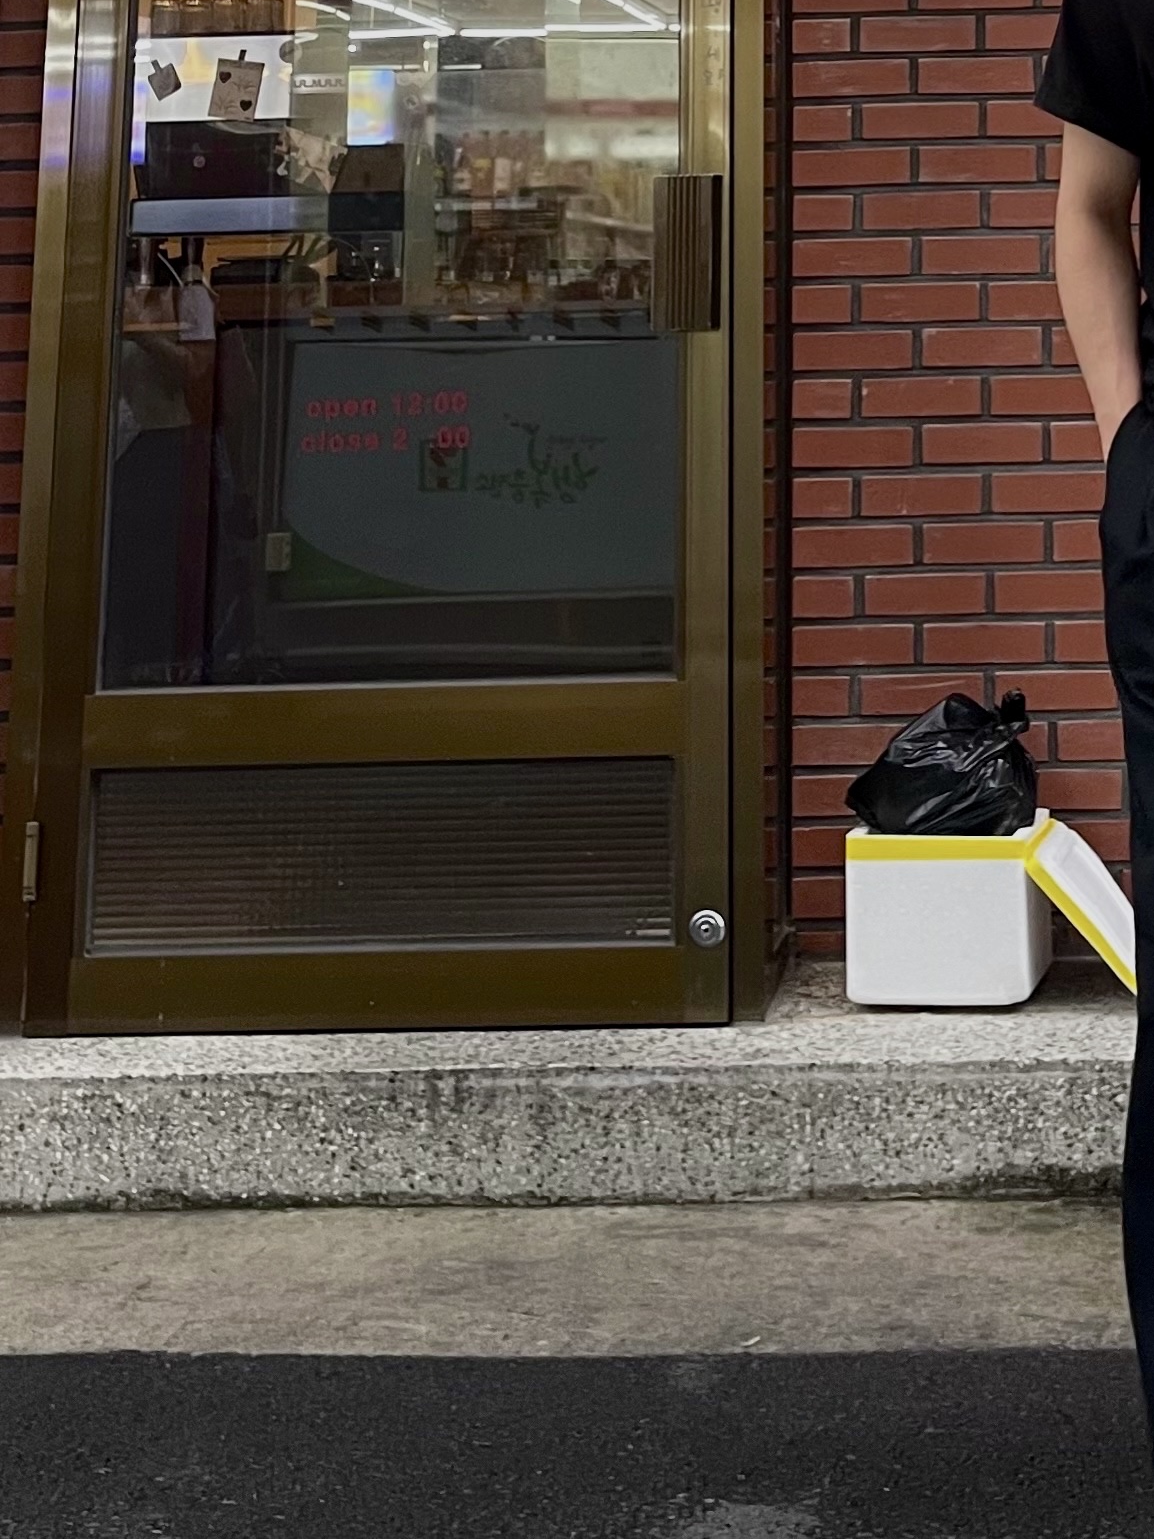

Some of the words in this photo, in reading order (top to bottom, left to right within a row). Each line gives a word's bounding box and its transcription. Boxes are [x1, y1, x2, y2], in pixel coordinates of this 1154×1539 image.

[306, 396, 377, 420] open
[391, 390, 469, 416] 12:00
[301, 431, 380, 453] close
[393, 425, 470, 452] 2:00
